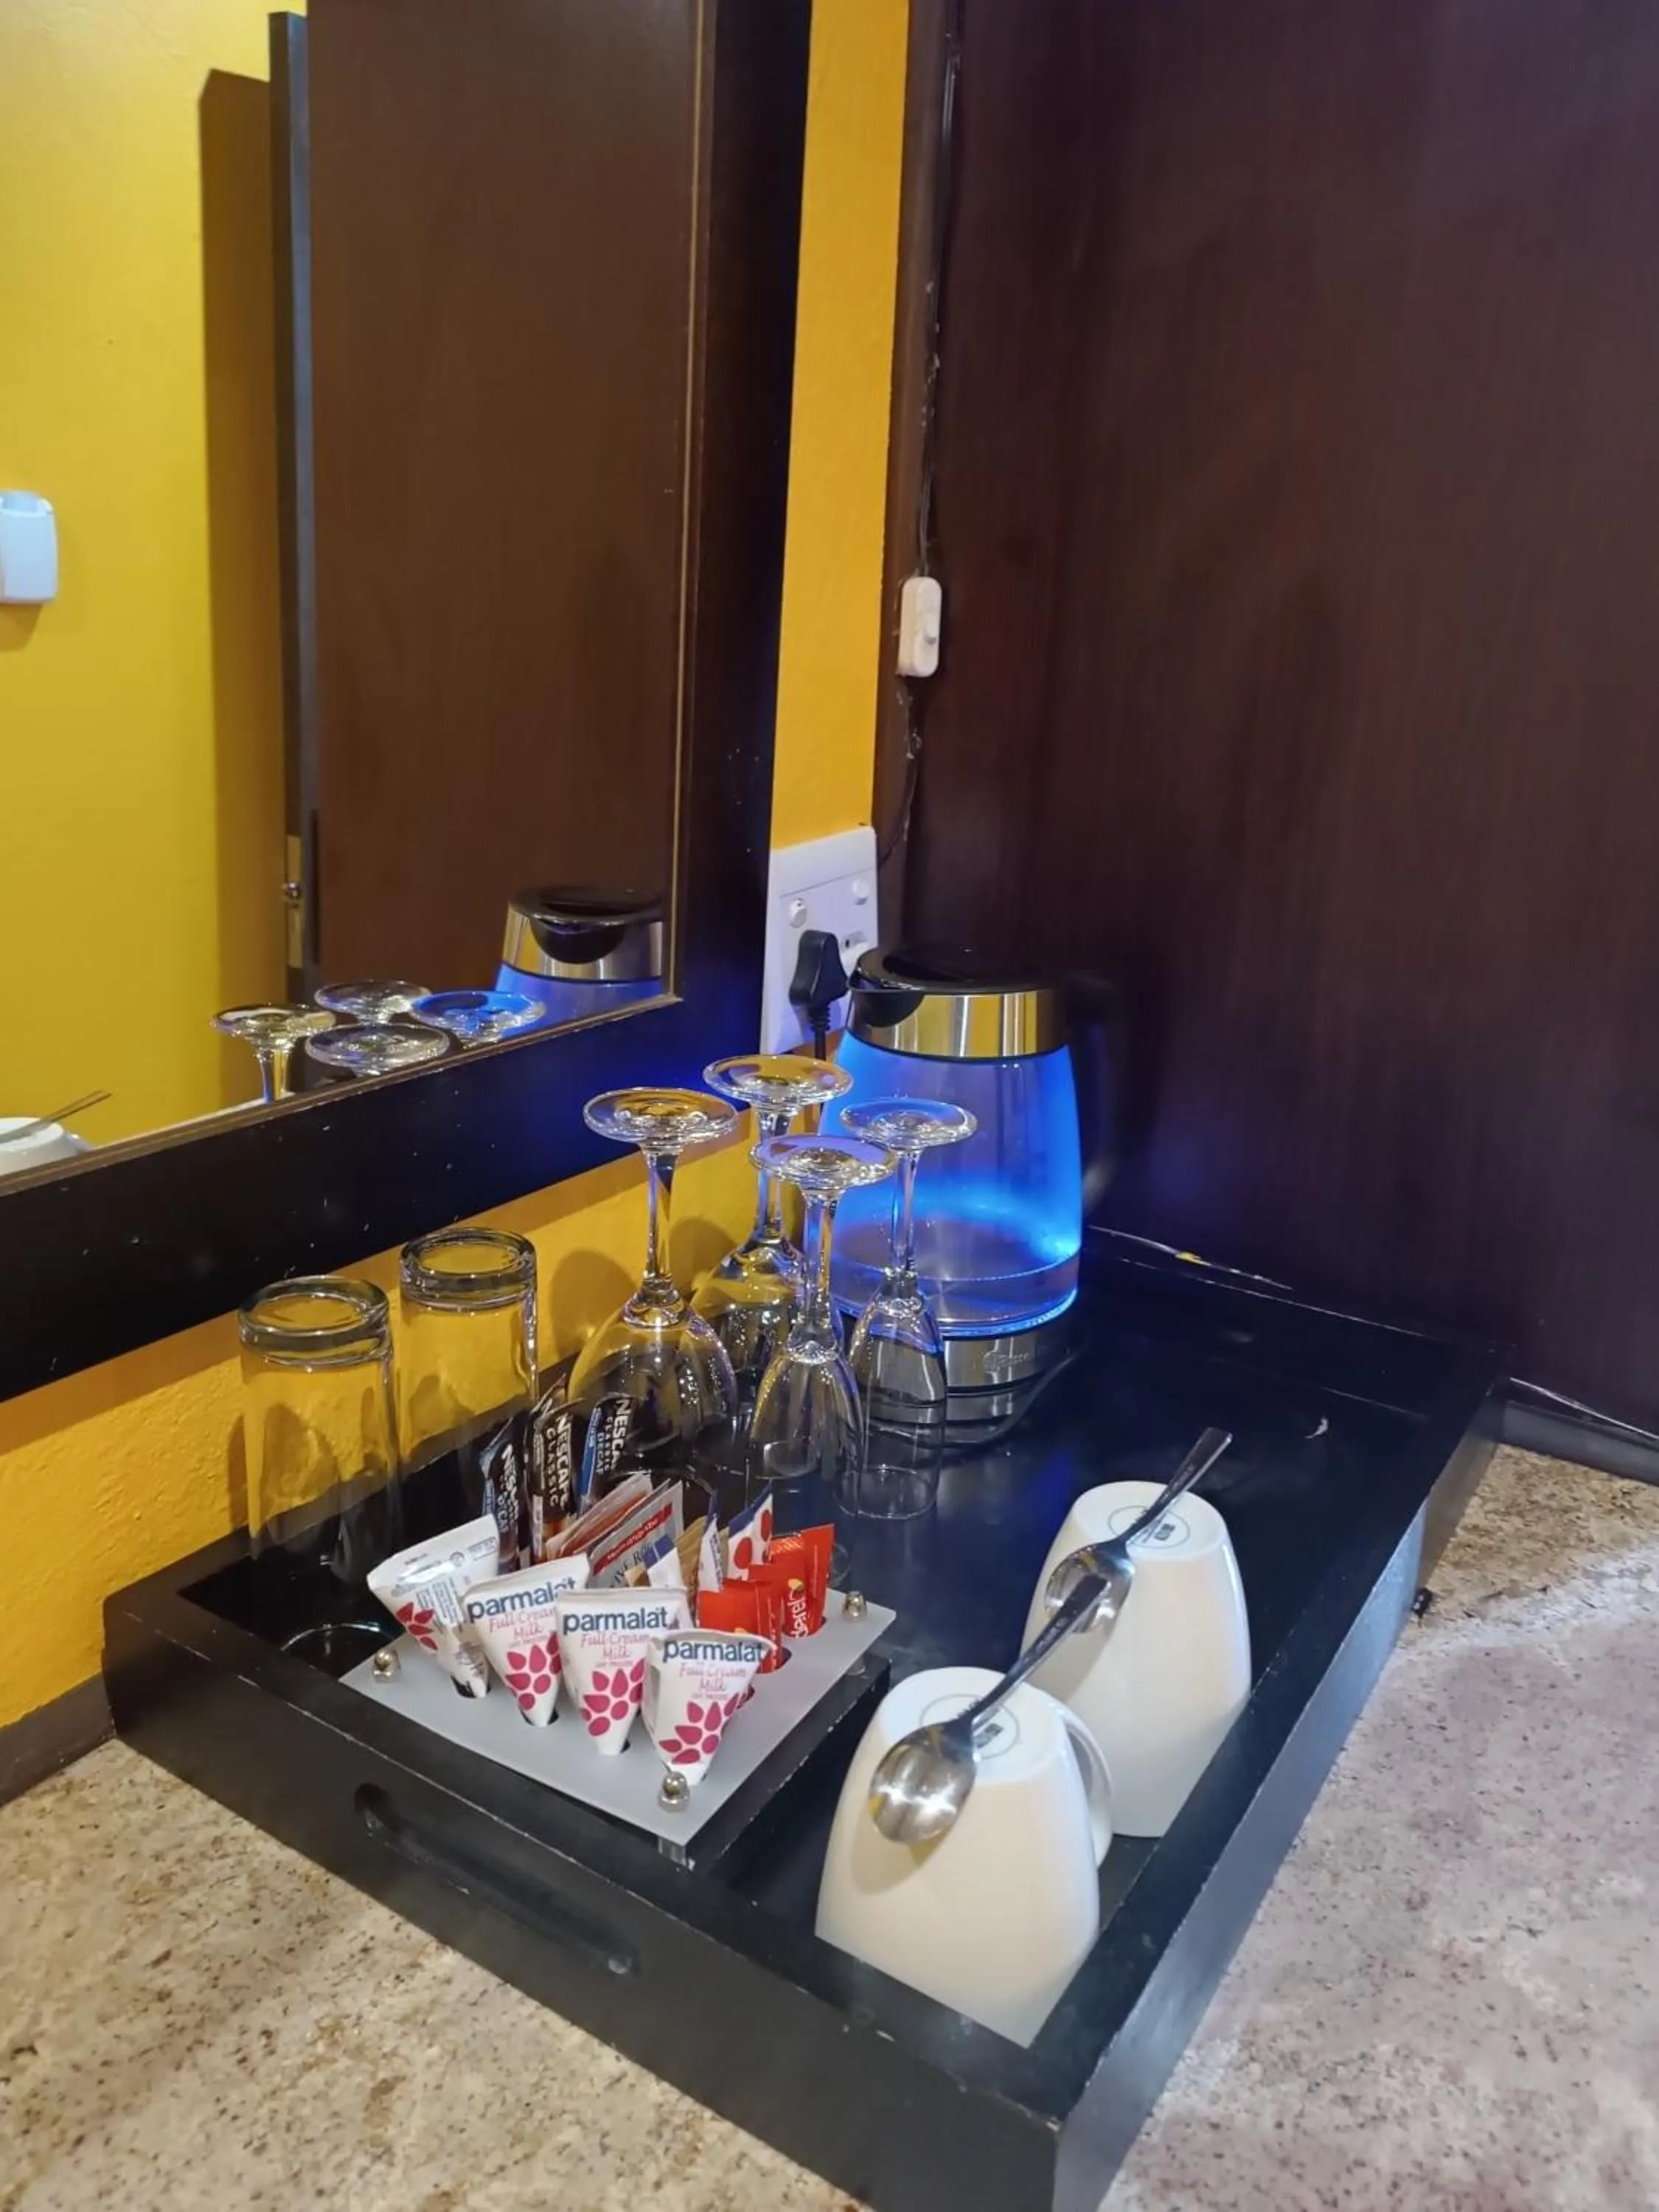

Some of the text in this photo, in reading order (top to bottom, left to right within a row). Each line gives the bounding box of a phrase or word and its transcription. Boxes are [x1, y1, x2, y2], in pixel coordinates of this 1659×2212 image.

[611, 1399, 632, 1472] NESCA
[546, 1427, 559, 1507] CLASSIC
[563, 1607, 668, 1635] parmalat
[662, 1640, 762, 1663] parmalat
